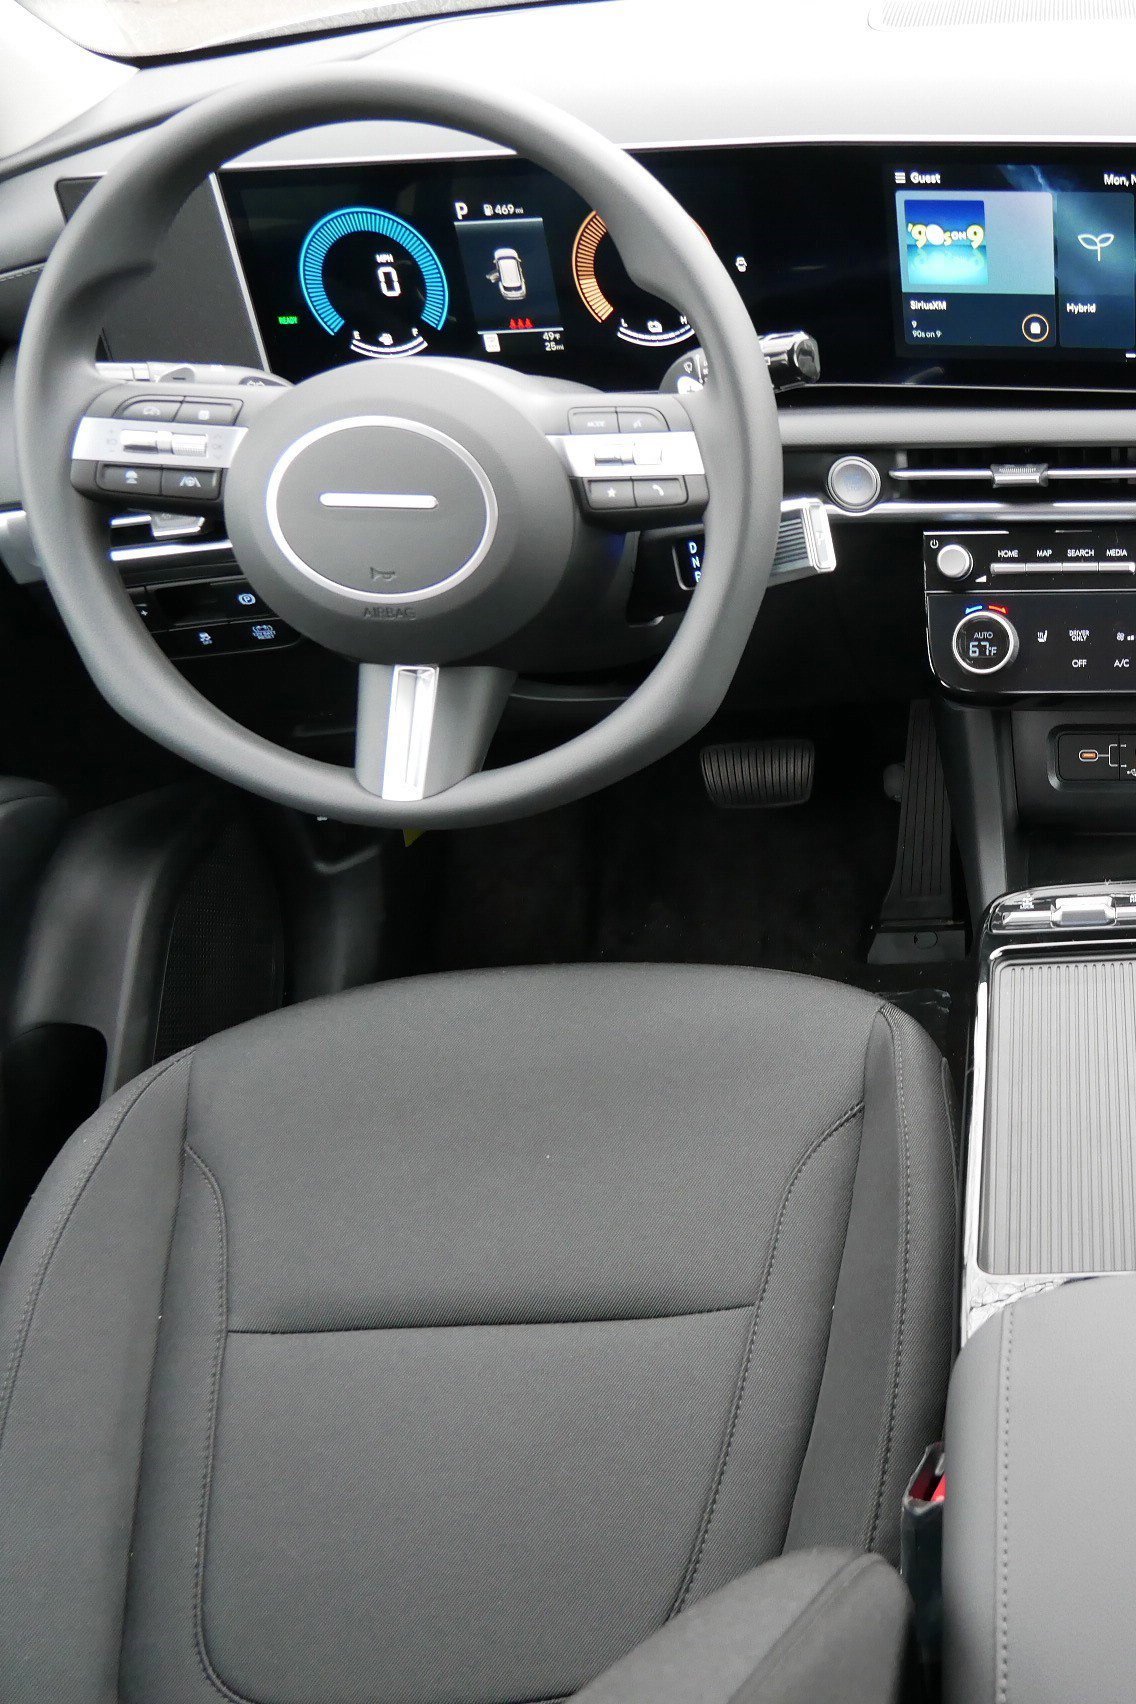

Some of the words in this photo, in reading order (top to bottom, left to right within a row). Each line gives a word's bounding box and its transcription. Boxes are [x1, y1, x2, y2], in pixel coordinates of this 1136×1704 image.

[910, 172, 941, 184] Guest
[1103, 173, 1129, 187] Mon,
[454, 201, 468, 220] P
[376, 253, 394, 263] MPH
[377, 266, 402, 297] 0
[910, 300, 947, 311] SiriusXM
[1066, 302, 1097, 315] Hybrid
[688, 541, 698, 555] D
[1067, 549, 1095, 557] SEARCH
[1106, 548, 1128, 557] MEDIA
[997, 550, 1019, 558] HOME
[1036, 549, 1053, 558] MAP
[691, 556, 701, 569] N
[363, 607, 417, 620] AIRBAG
[973, 631, 994, 640] AUTO
[1068, 629, 1090, 637] DRIVER
[1071, 659, 1088, 668] OFF
[1113, 658, 1130, 668] A/C
